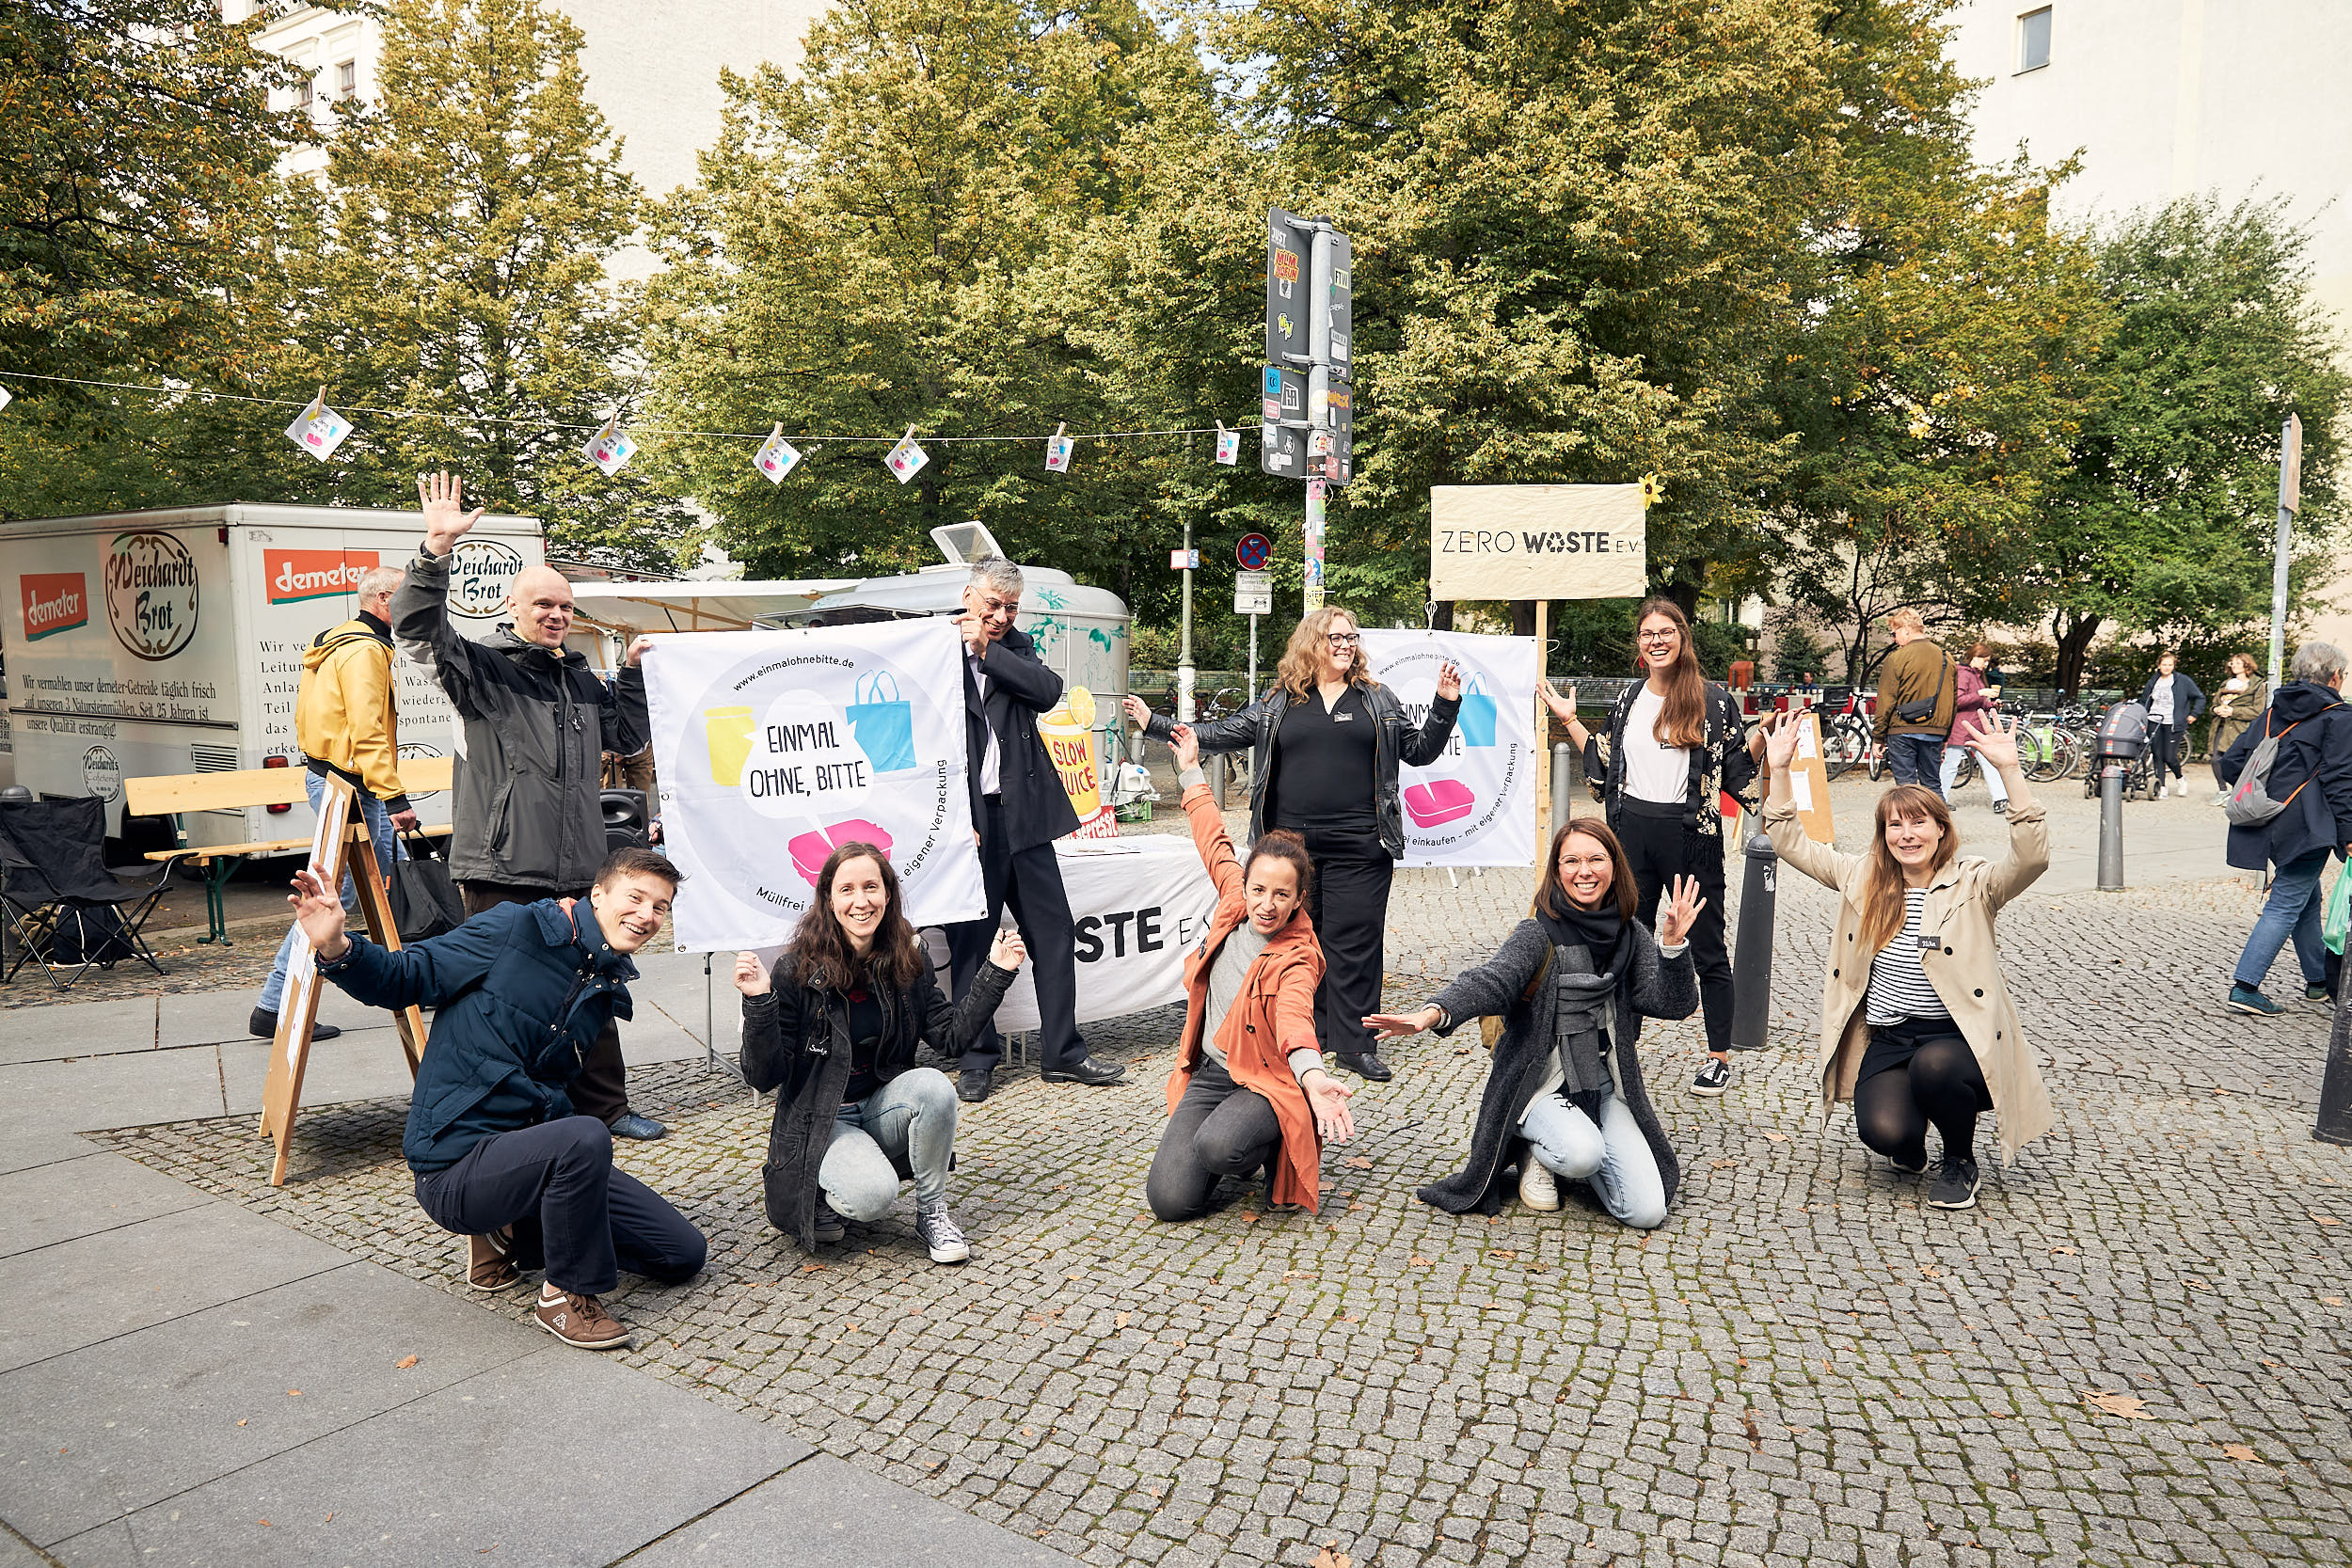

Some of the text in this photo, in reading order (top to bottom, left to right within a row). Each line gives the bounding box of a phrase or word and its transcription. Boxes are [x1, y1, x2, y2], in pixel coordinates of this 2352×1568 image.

[1440, 531, 1515, 553] ZERO
[109, 548, 195, 590] Weichardt
[275, 562, 368, 593] demeter
[463, 577, 501, 602] Brot
[28, 589, 79, 626] demeter
[135, 591, 174, 635] Brot
[260, 641, 310, 654] Wir ve
[261, 657, 406, 673] Leitun ch
[734, 655, 854, 691] www.einmalohnebitte.de
[23, 674, 216, 700] Wir vermahlen unser demeter-Getreide täglich frisch
[263, 682, 299, 694] Anlag
[405, 676, 432, 687] Was
[37, 698, 63, 711] unseren
[65, 697, 71, 711] 3
[139, 703, 153, 717] Seit
[157, 703, 167, 718] 25
[170, 704, 196, 721] Jahren
[199, 705, 210, 721] ist
[264, 702, 291, 715] Teil
[1400, 704, 1430, 723] INM
[26, 718, 48, 731] unsere
[50, 716, 76, 734] Qualität
[266, 721, 288, 735] das
[767, 721, 839, 752] EINMAL
[1053, 737, 1089, 766] SLOW
[1442, 736, 1461, 755] TE
[750, 760, 866, 797] OHNE, BITTE
[1402, 835, 1410, 845] ei
[1412, 836, 1456, 847] einkaufen
[1465, 824, 1479, 837] mit
[1479, 797, 1503, 827] eigener
[1499, 742, 1518, 798] Verpackung
[755, 759, 946, 911] Müllfrei eigener Verpackung
[1074, 906, 1164, 963] STE
